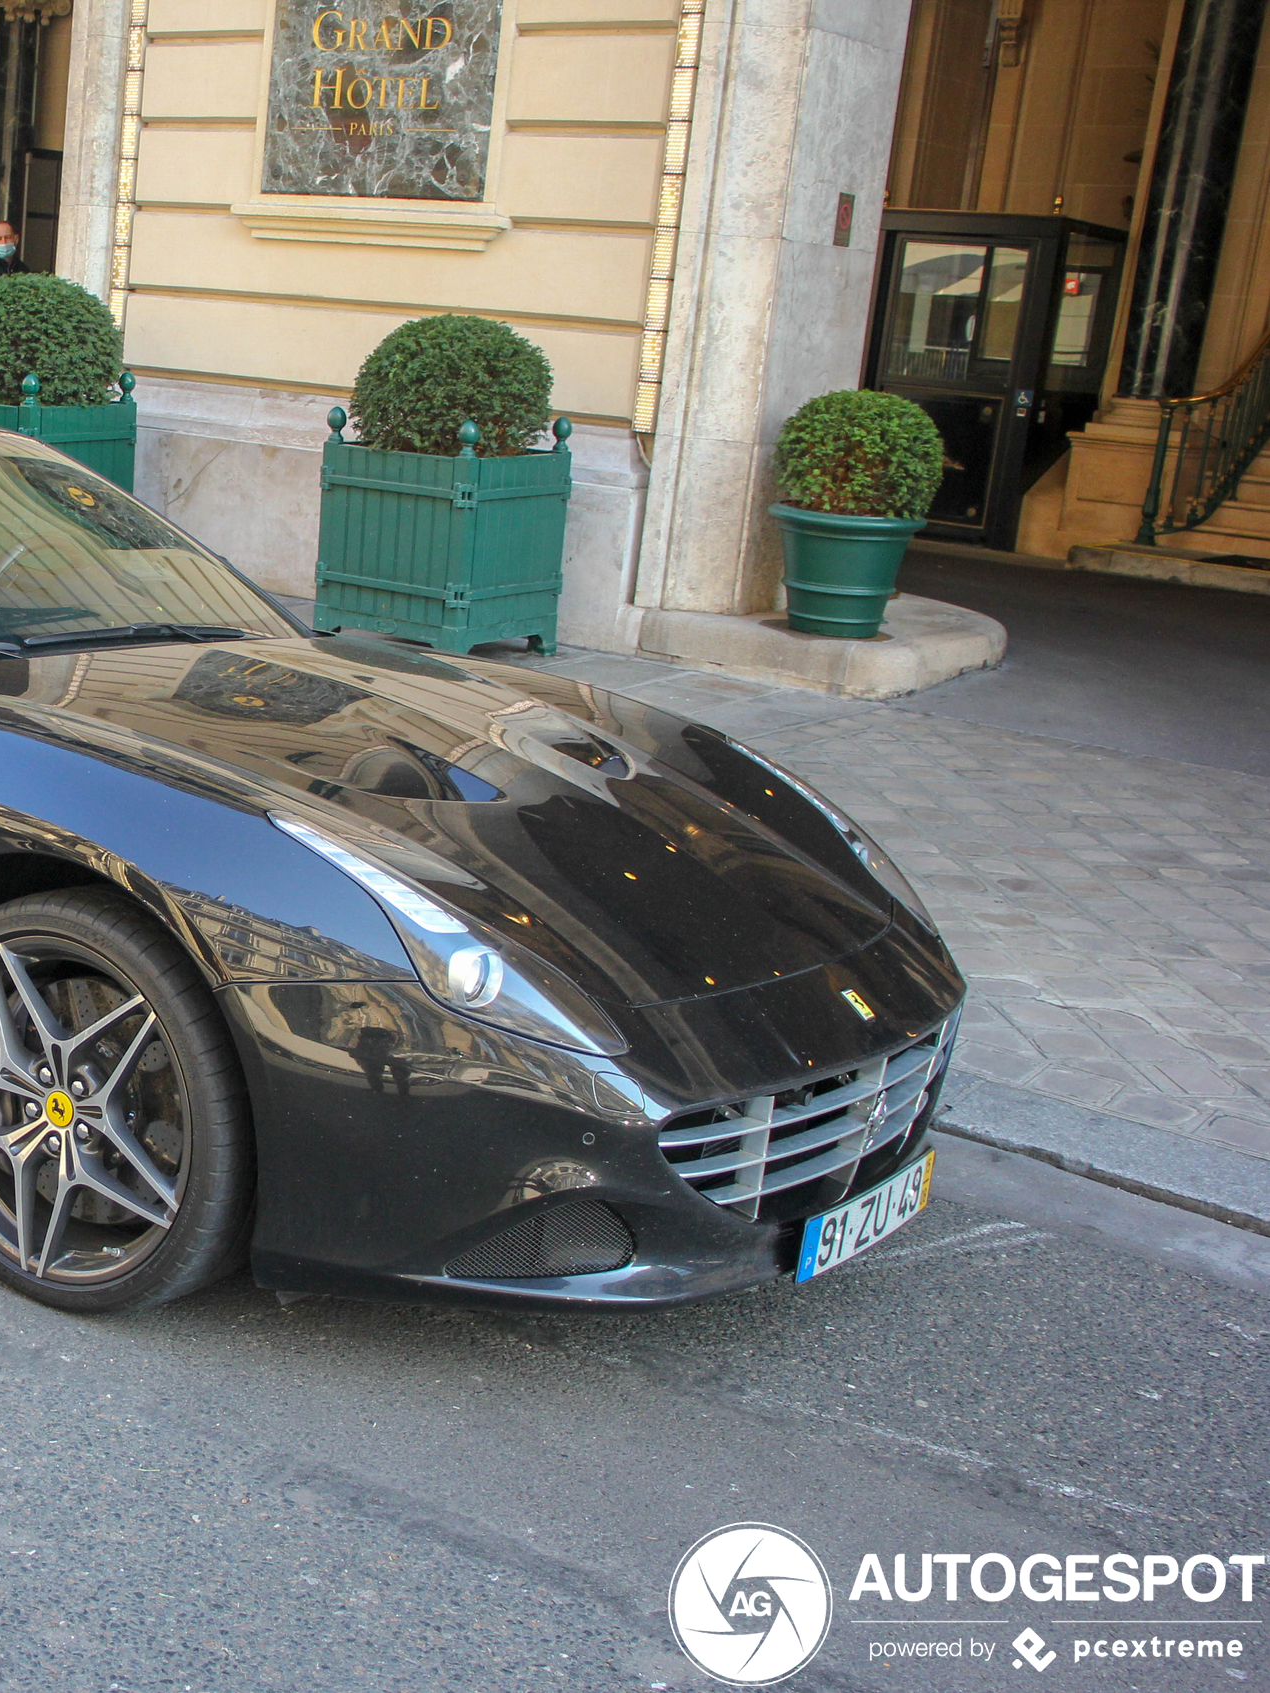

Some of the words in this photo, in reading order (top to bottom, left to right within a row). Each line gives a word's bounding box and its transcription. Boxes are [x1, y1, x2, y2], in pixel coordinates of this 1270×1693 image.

[312, 10, 453, 51] GRAND
[309, 68, 440, 110] HÔTEL
[349, 122, 395, 137] PARIS
